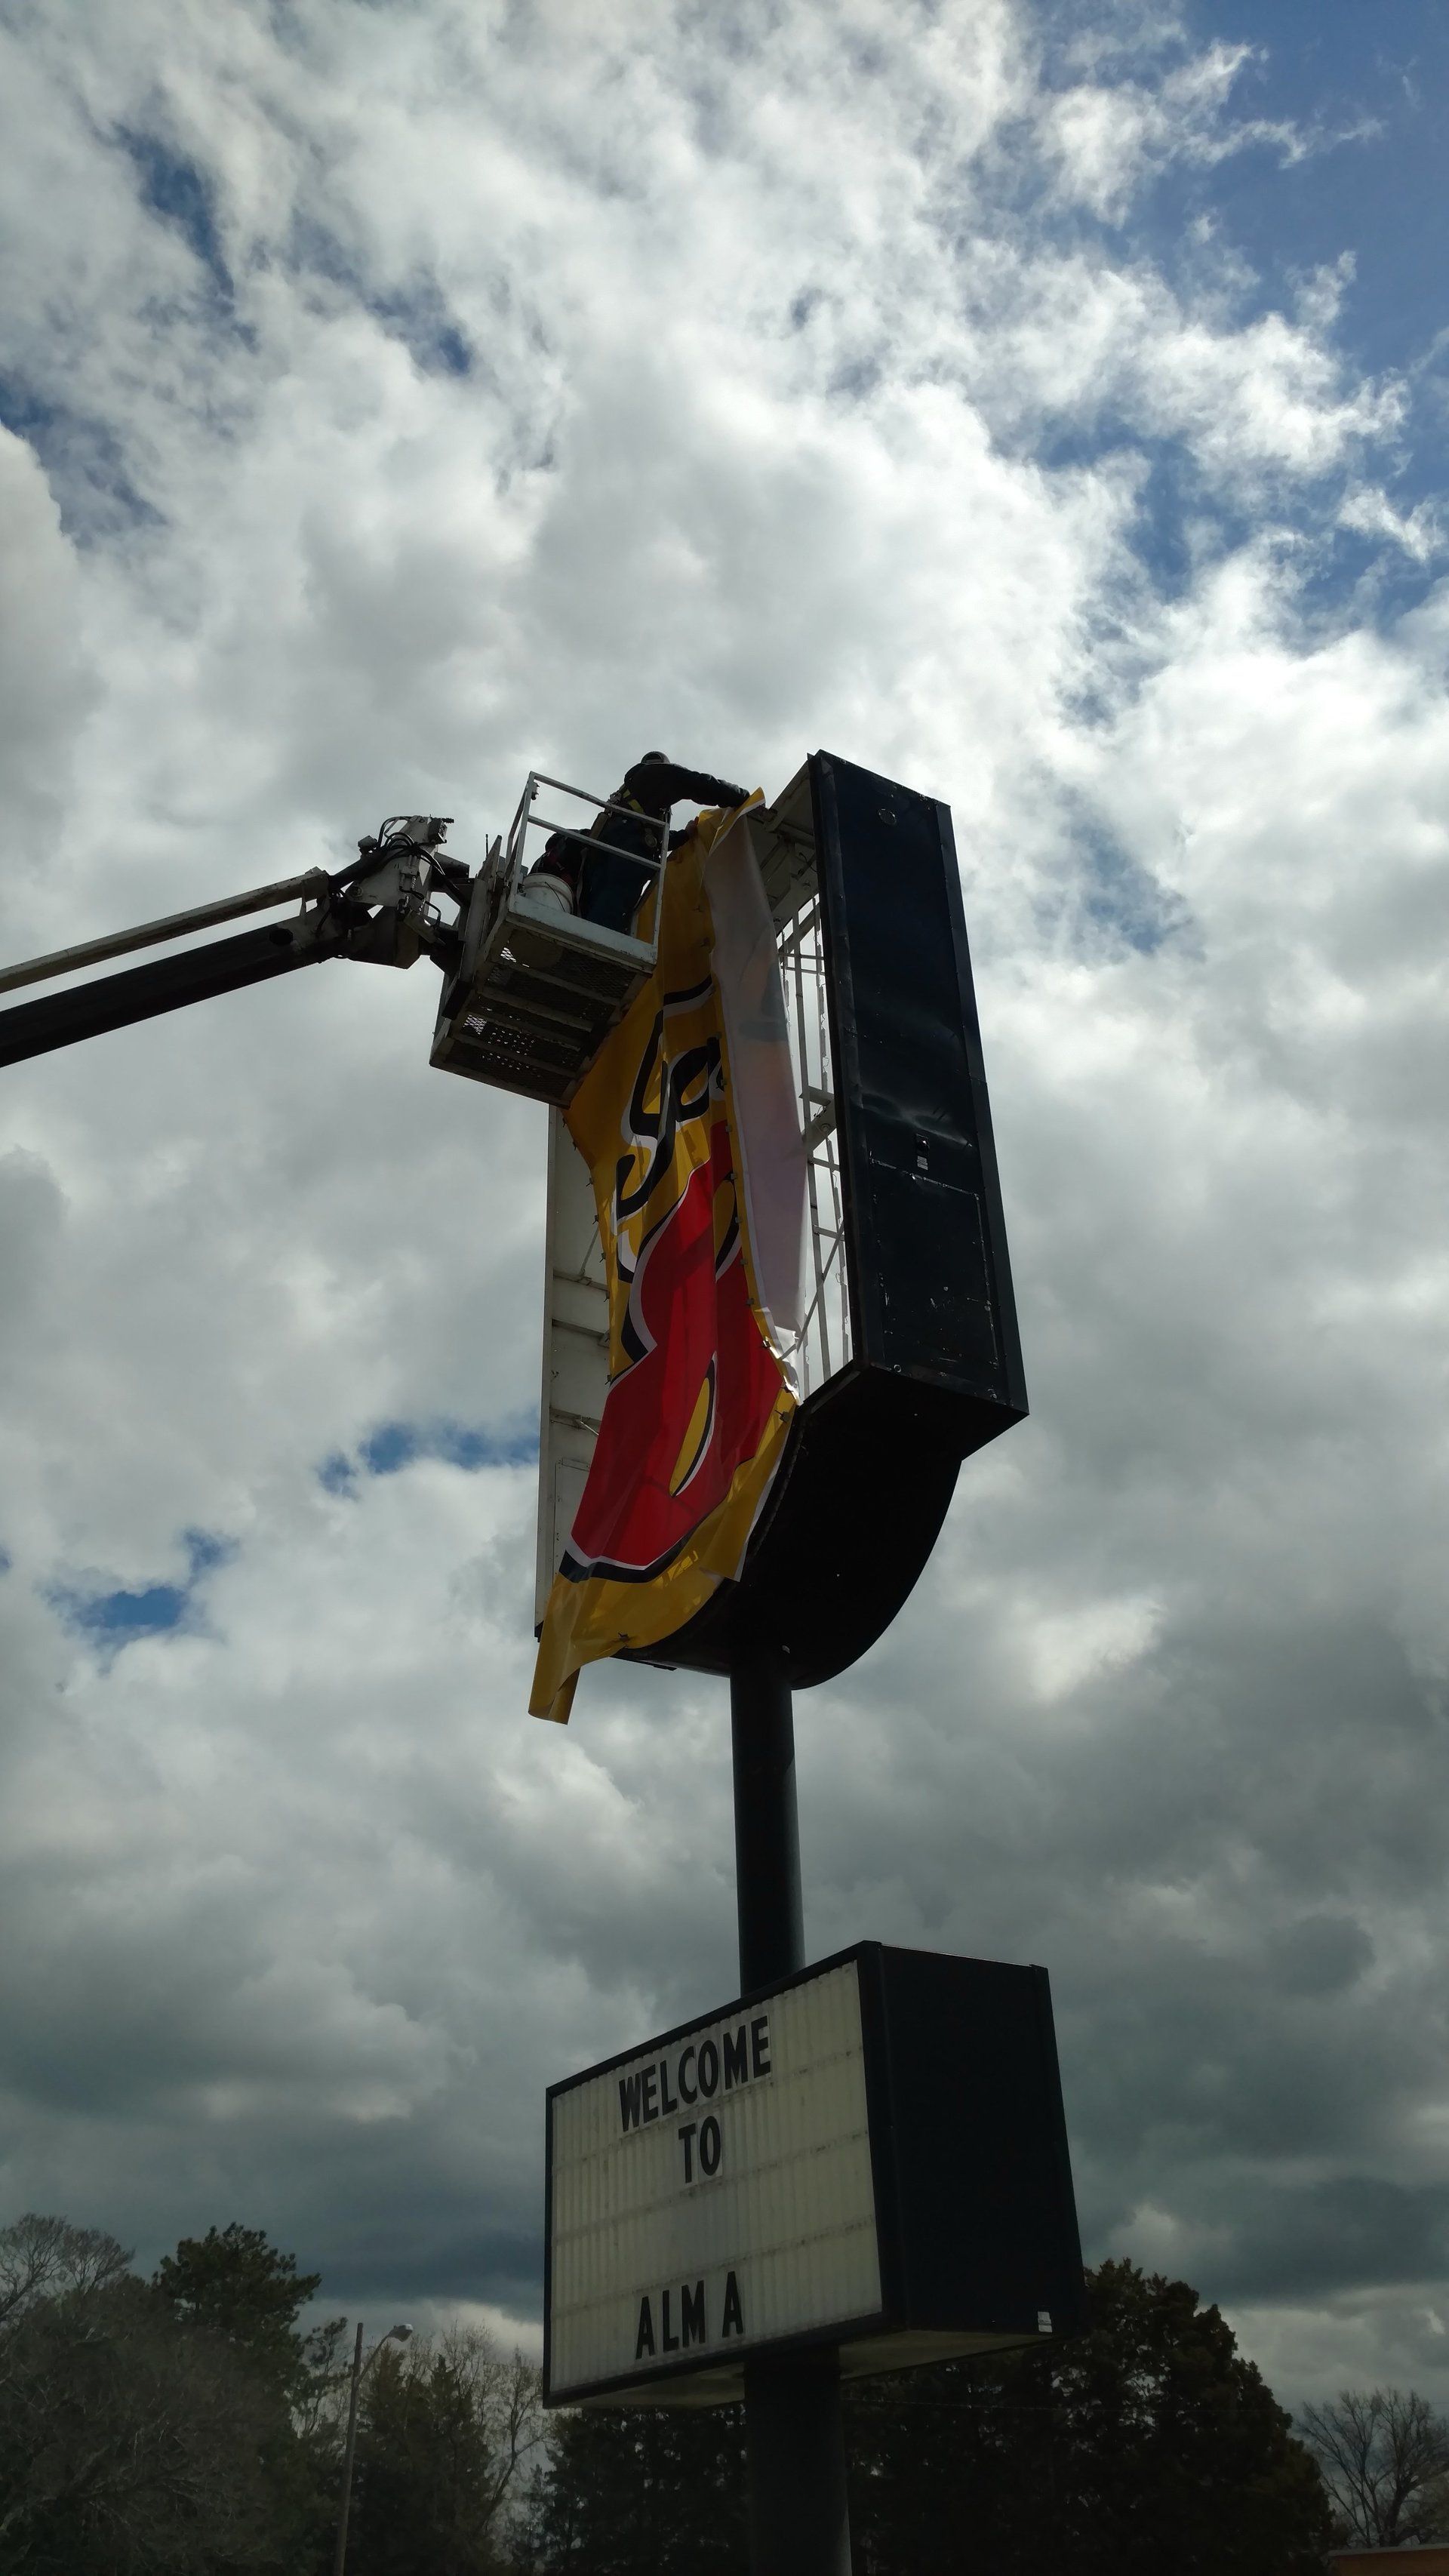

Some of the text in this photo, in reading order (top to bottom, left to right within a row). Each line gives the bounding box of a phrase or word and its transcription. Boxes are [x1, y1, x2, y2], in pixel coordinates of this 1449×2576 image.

[619, 2015, 771, 2131] WELCOME
[679, 2116, 721, 2184] TO
[635, 2271, 743, 2359] ALMA
